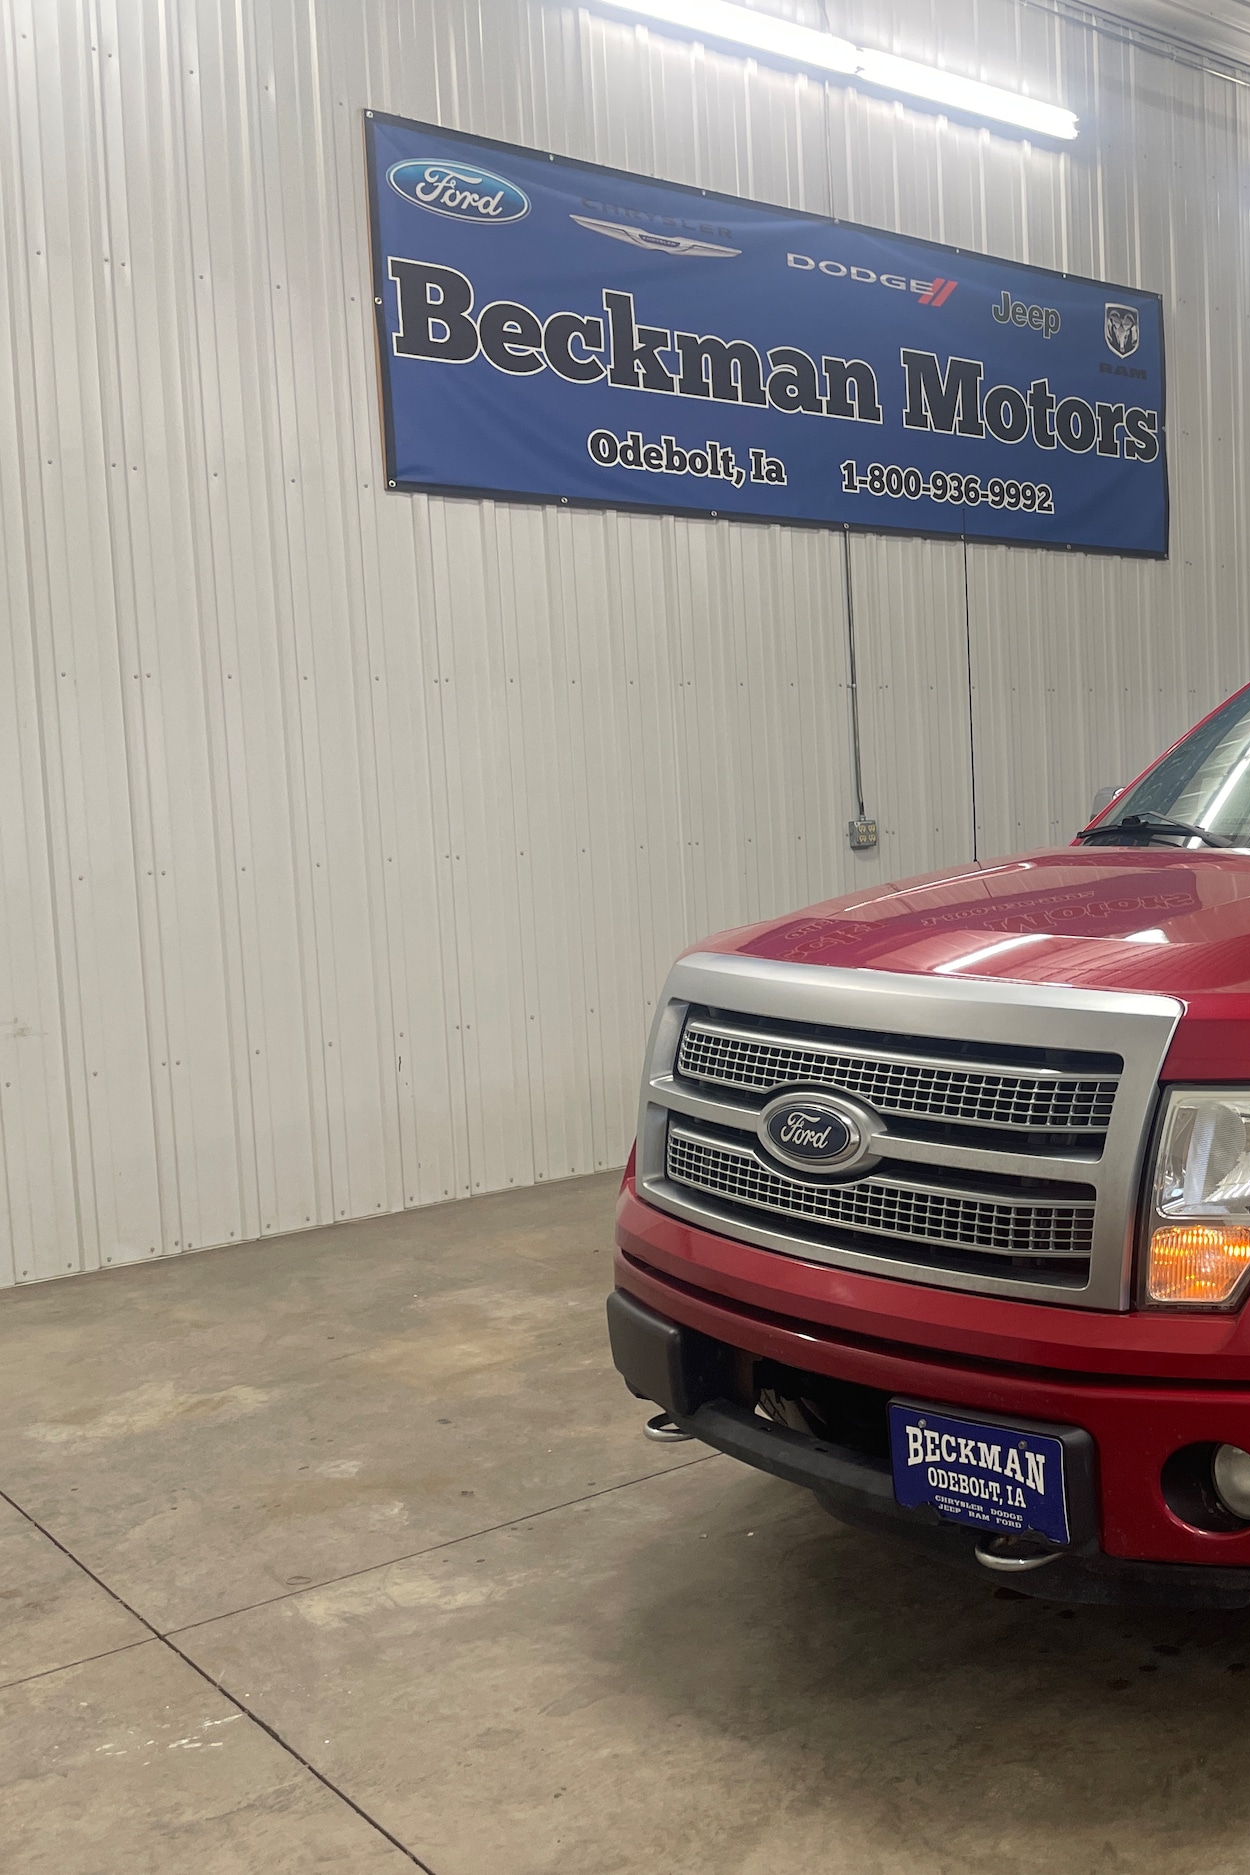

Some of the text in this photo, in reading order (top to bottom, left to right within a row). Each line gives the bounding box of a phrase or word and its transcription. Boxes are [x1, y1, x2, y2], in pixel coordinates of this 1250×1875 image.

[415, 166, 505, 218] Ford
[580, 197, 733, 239] CHRYSLER
[786, 252, 935, 296] DODGE
[992, 290, 1061, 339] Jeep
[387, 256, 1159, 463] Beckman Motors
[1099, 361, 1148, 381] RAM
[587, 428, 788, 489] Odebolt, Ia
[840, 459, 1055, 514] 1-800-936-9992
[780, 1111, 833, 1149] Ford
[905, 1424, 1046, 1496] BECKMAN
[927, 1466, 1027, 1509] ODEBOLT, IA
[934, 1494, 1023, 1522] CHRYSLER DODGE
[938, 1503, 1022, 1529] JEEP RAM FORD
